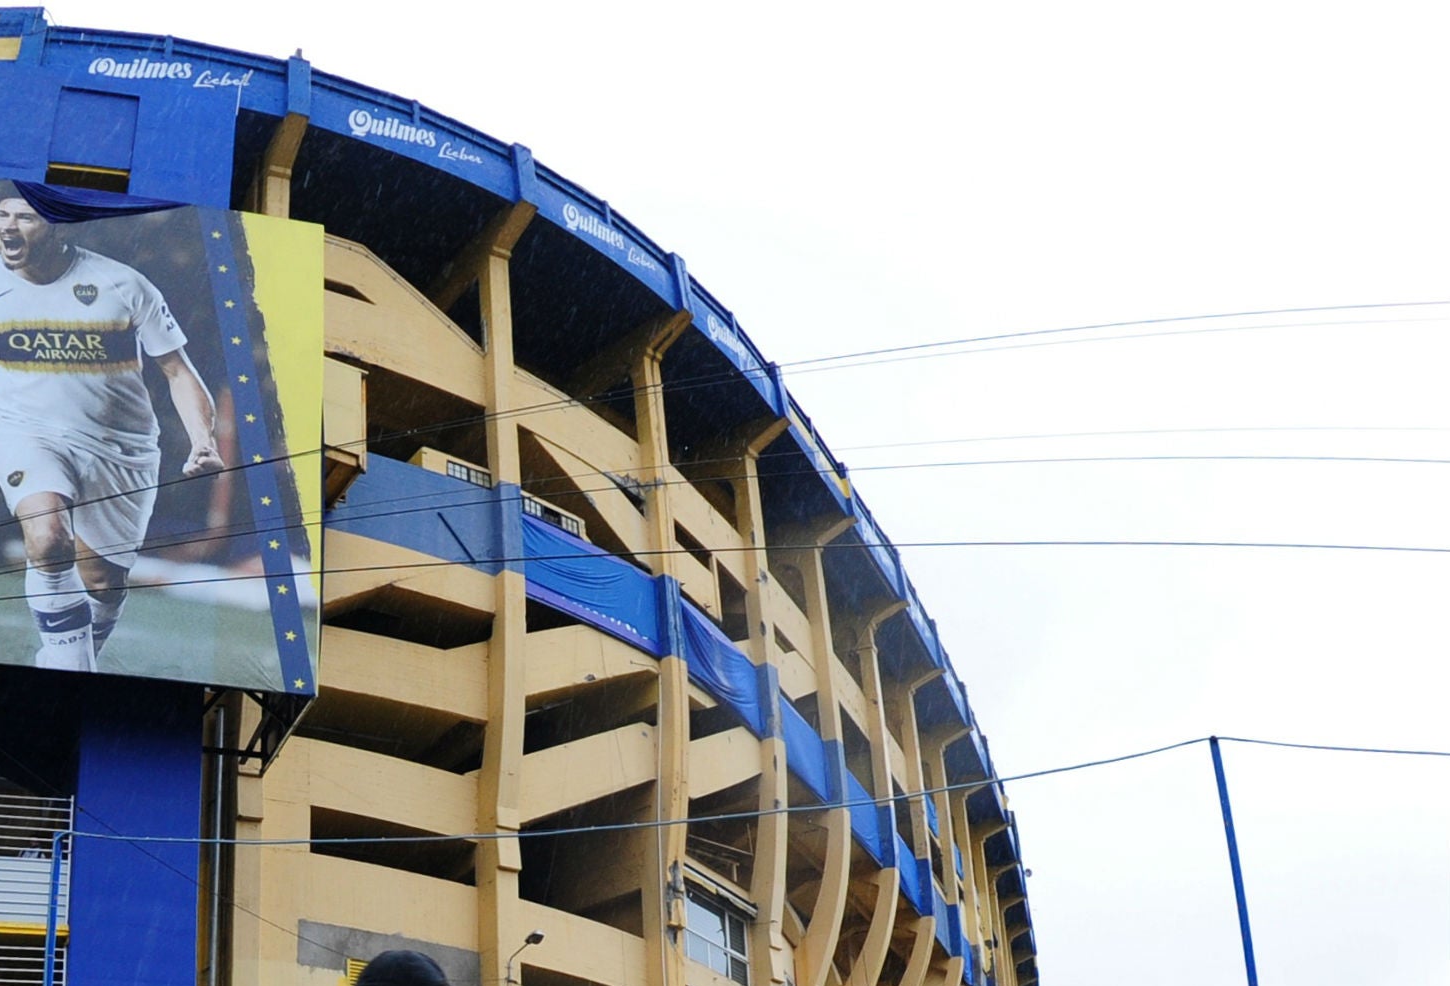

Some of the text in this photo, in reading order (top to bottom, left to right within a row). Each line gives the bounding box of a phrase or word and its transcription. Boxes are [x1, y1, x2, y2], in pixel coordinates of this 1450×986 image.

[88, 58, 192, 79] Quilmes
[349, 109, 436, 148] Quilmes
[563, 203, 624, 250] Quilmes
[9, 332, 104, 351] QATAR
[35, 349, 107, 360] AIRWAYS
